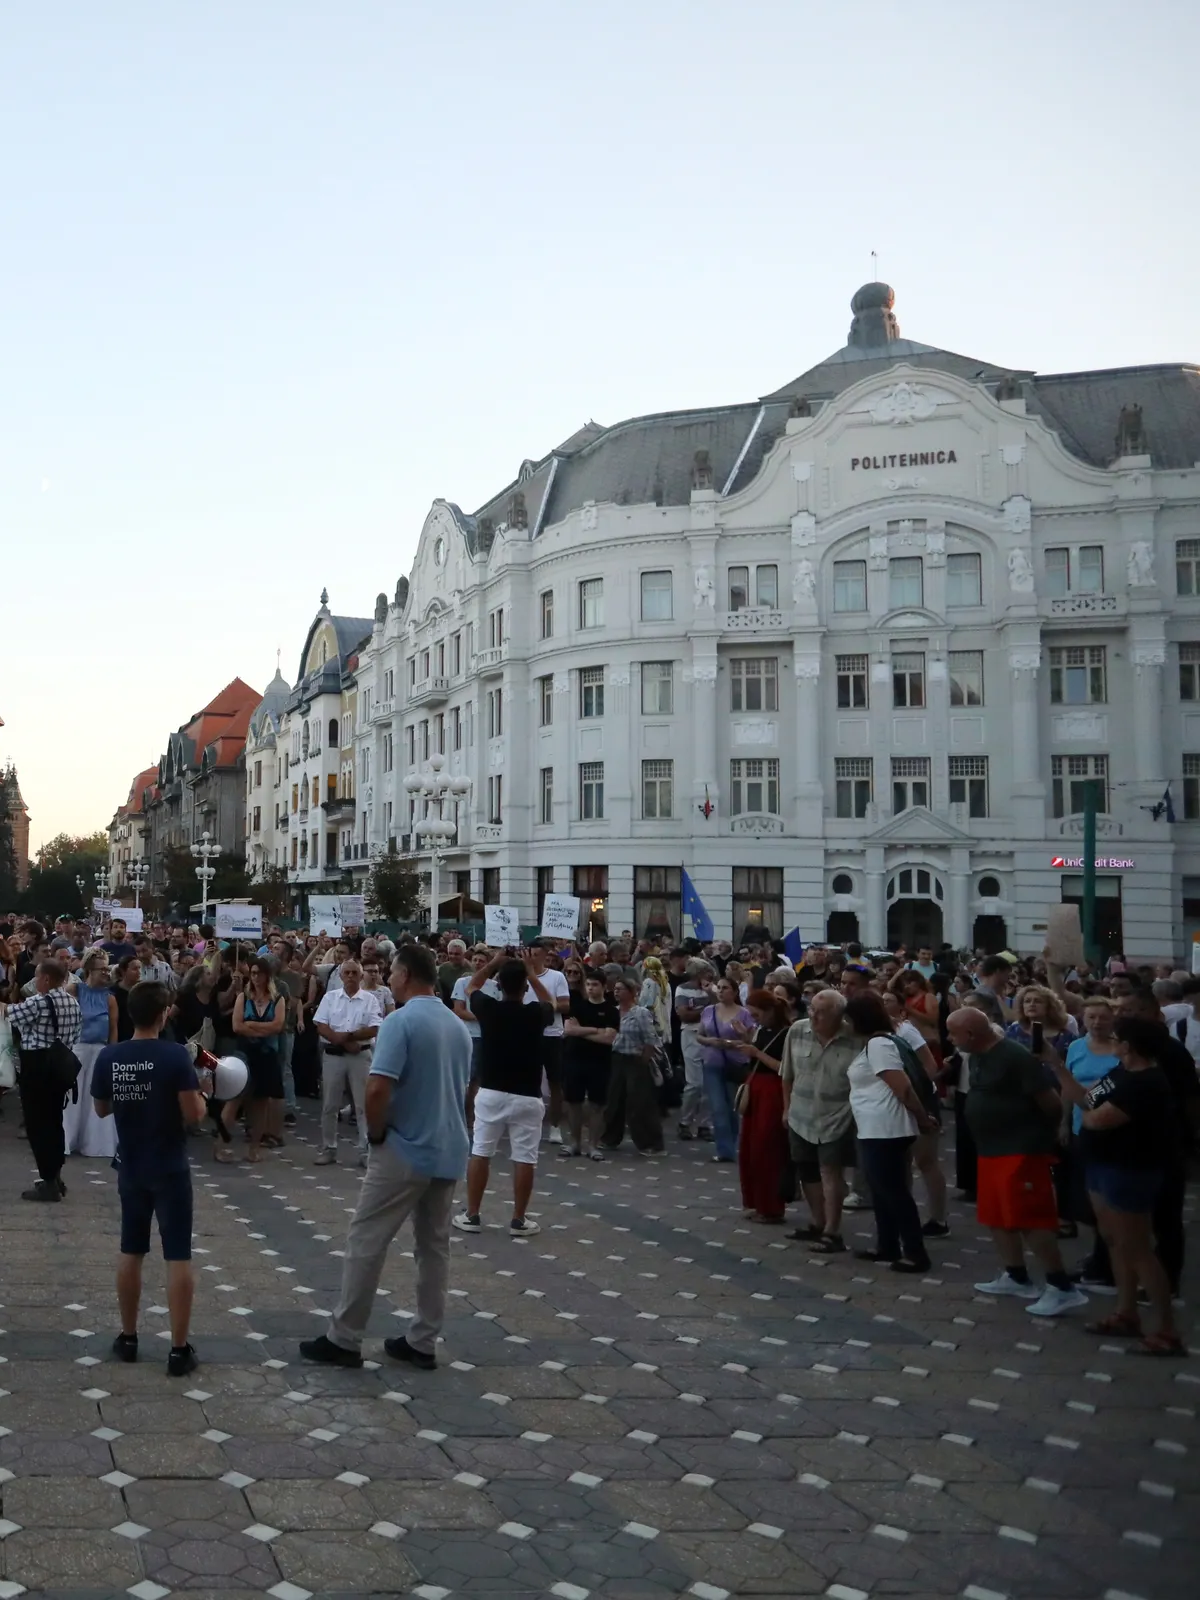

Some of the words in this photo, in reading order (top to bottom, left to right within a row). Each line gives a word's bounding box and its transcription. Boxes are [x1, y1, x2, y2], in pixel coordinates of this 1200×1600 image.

[851, 450, 957, 471] POLITEHNICA
[1063, 857, 1107, 868] UniCdit
[1109, 857, 1135, 868] Bank
[112, 1060, 154, 1072] Dominic
[112, 1072, 136, 1082] Fritz
[112, 1082, 152, 1092] Primarul
[113, 1091, 147, 1101] nostru.
